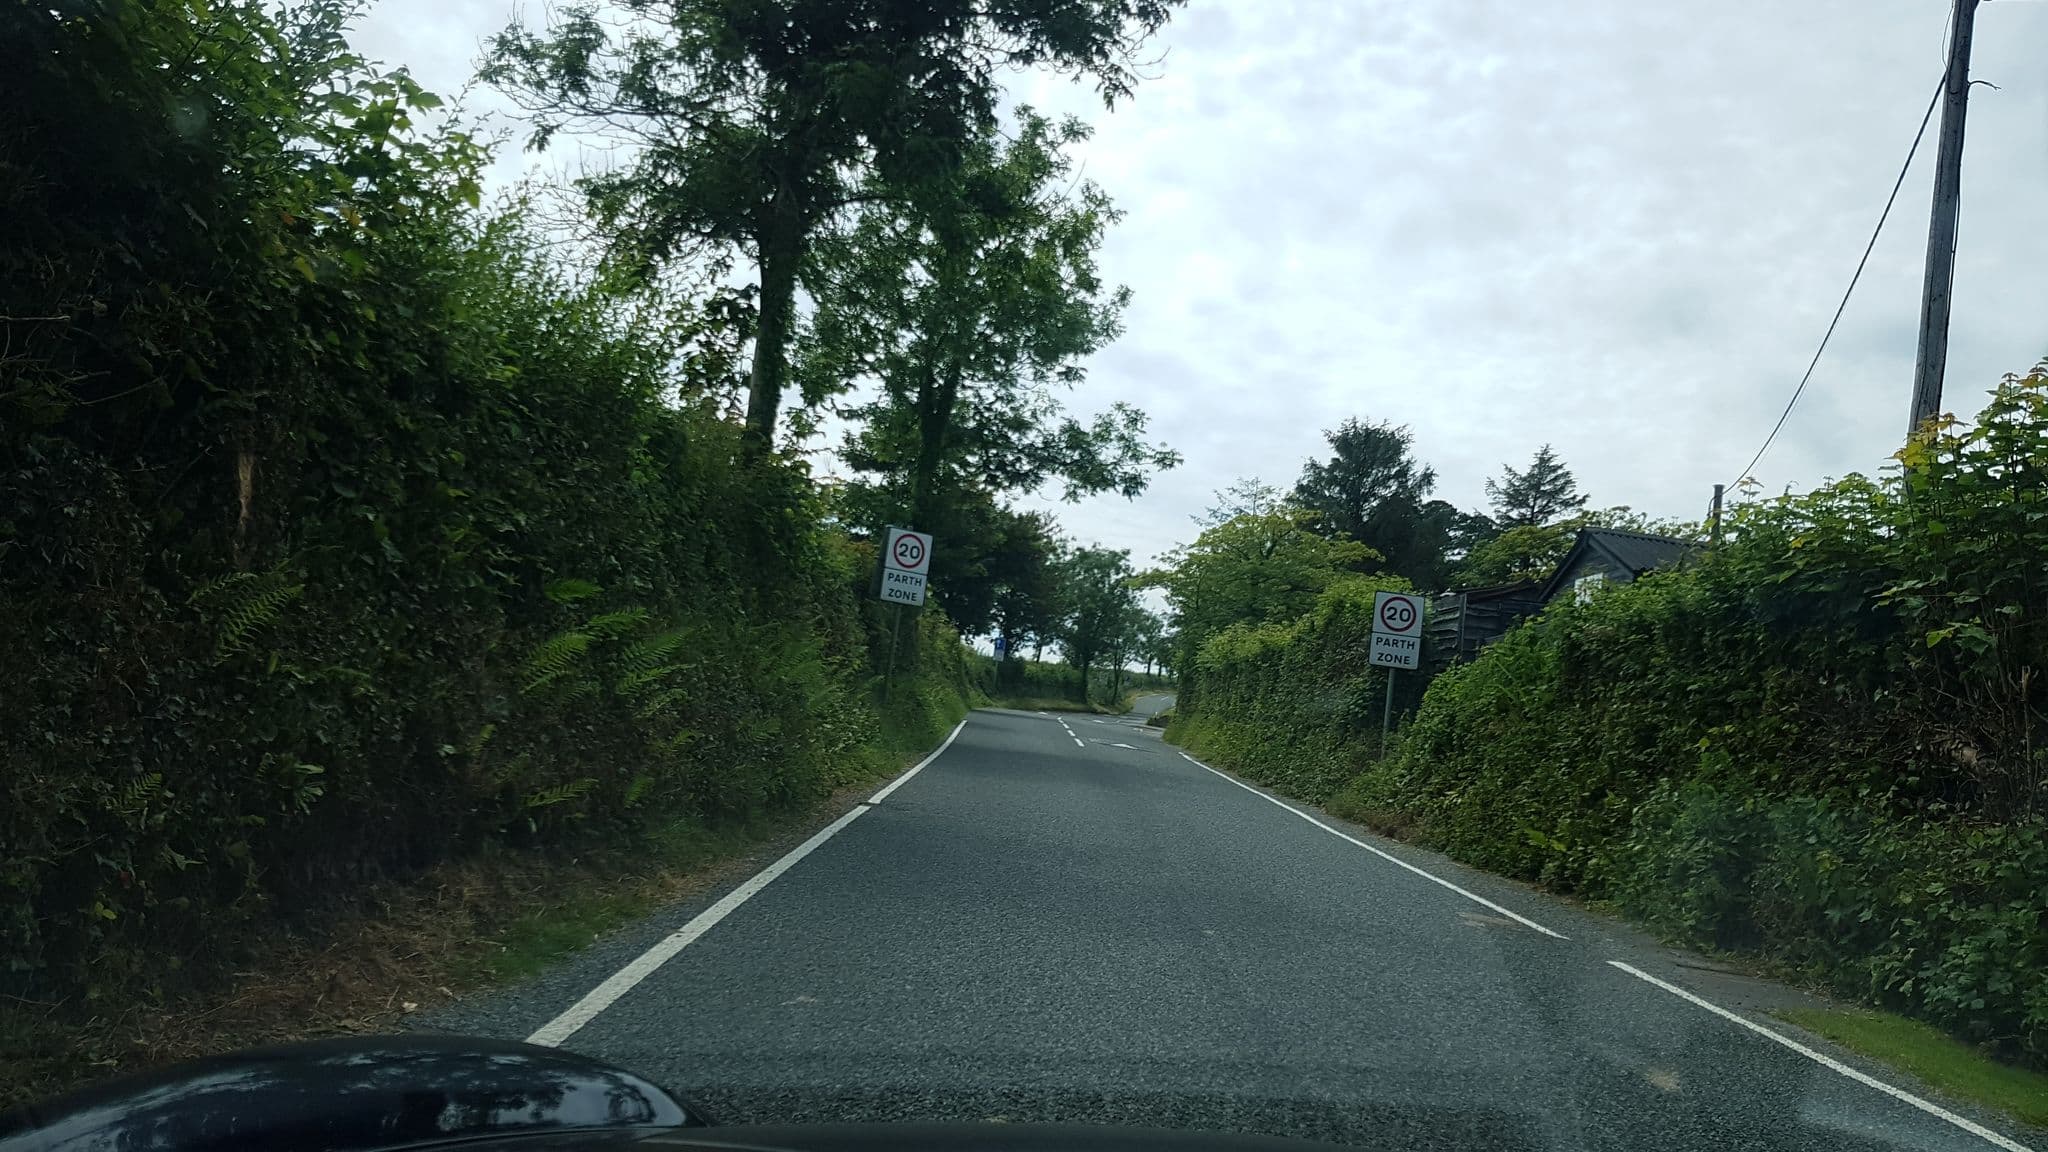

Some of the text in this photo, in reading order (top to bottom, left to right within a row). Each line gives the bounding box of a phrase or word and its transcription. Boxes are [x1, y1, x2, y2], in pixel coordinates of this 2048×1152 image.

[898, 543, 920, 560] 20
[888, 572, 922, 587] PARTH
[888, 588, 918, 601] ZONE
[1386, 606, 1411, 622] 20
[1375, 637, 1415, 650] PARTH
[1377, 652, 1410, 665] ZONE
